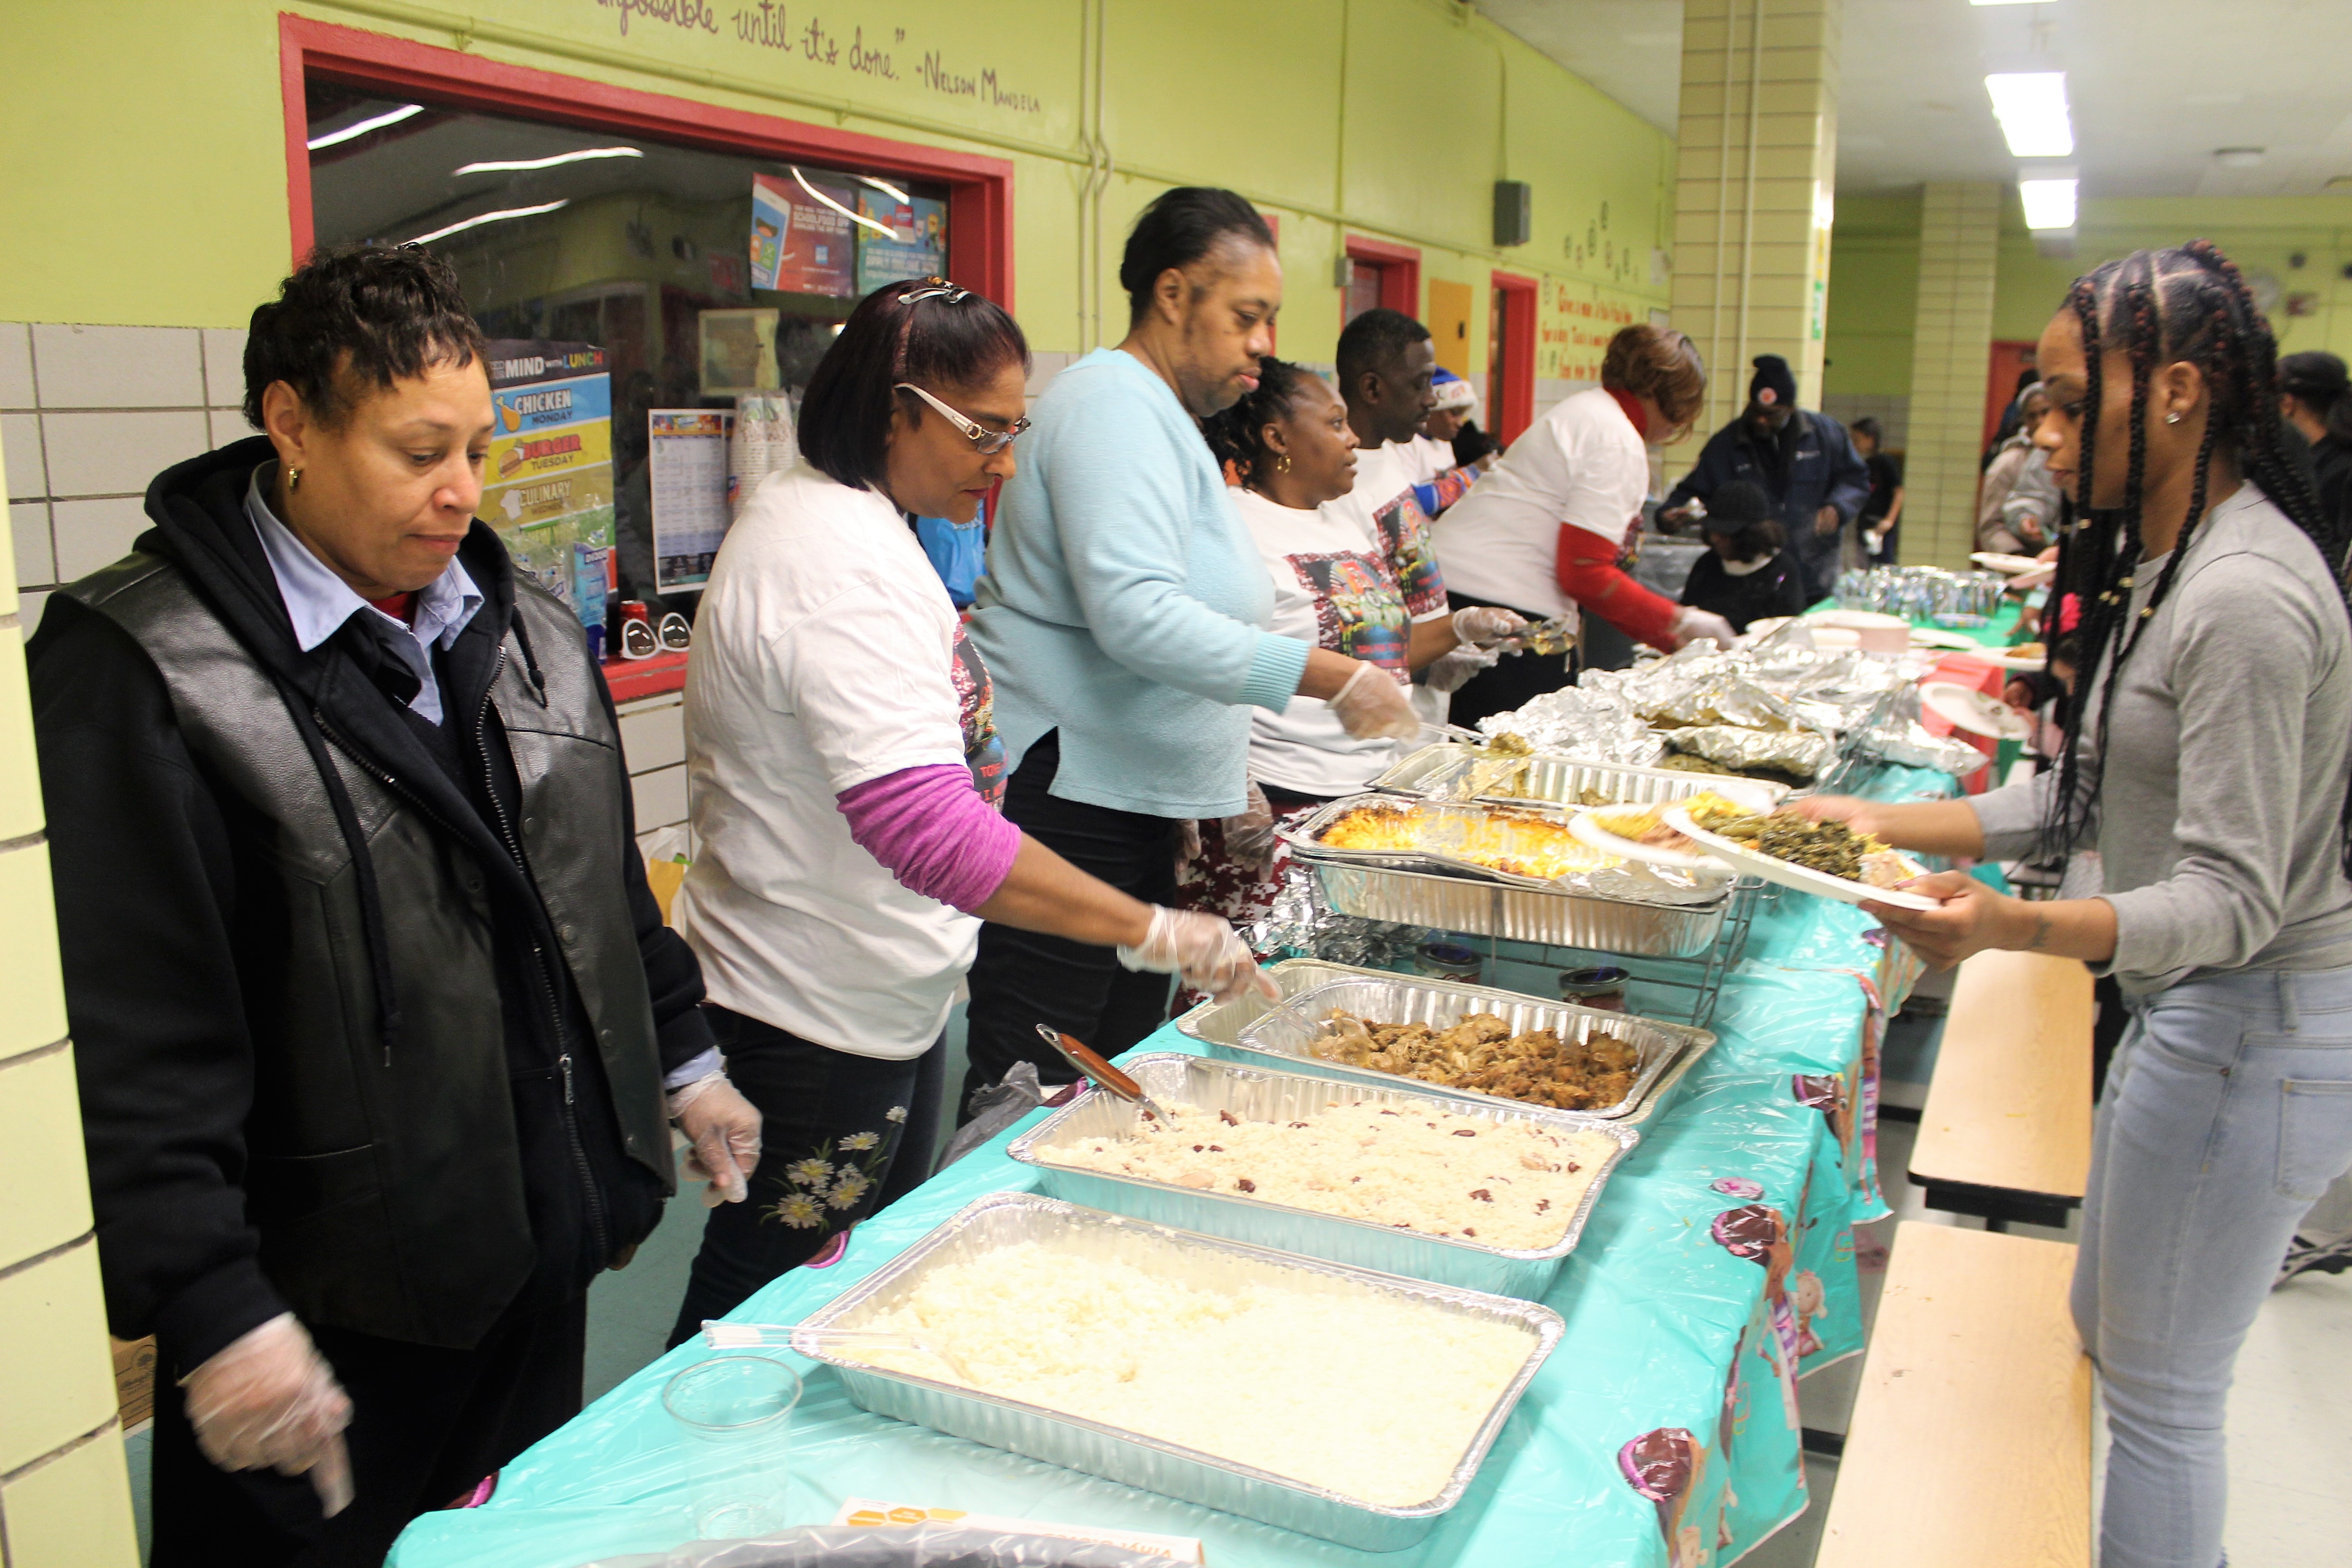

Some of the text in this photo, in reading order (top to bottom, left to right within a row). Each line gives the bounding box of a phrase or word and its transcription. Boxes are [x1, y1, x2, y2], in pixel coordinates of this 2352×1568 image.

[598, 0, 718, 36] possible
[731, 0, 791, 51] until
[800, 17, 838, 65] it's
[981, 68, 1040, 112] MANDELA
[505, 356, 545, 378] MIND
[562, 351, 603, 369] LUNCH
[514, 389, 572, 415] CHICKEN
[532, 411, 573, 425] MONDAY
[524, 434, 581, 461] BURGER
[531, 455, 573, 470] TUESDAY
[520, 480, 572, 507] CULINARY
